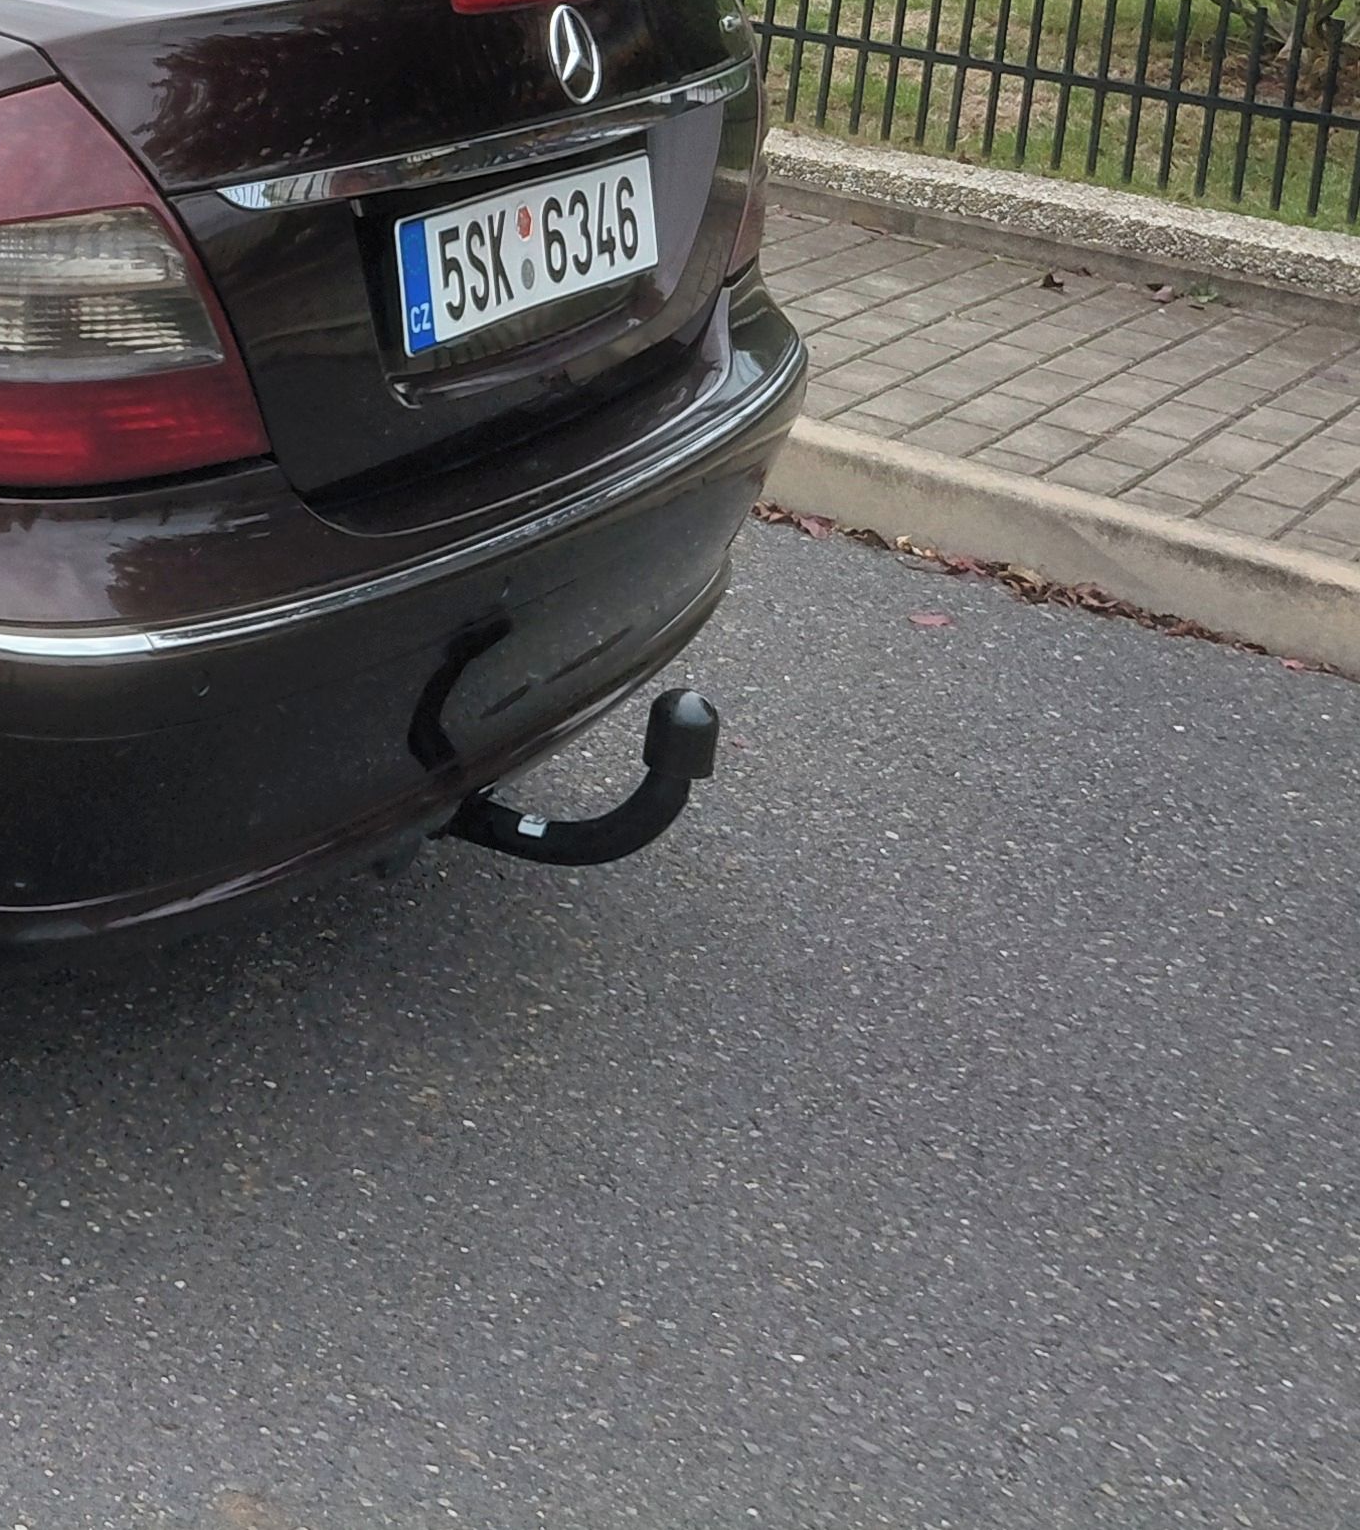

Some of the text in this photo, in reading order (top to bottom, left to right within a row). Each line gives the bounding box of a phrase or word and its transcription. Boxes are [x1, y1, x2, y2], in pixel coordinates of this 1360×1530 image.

[437, 175, 639, 321] 5SK 6346
[410, 302, 432, 334] CZ
